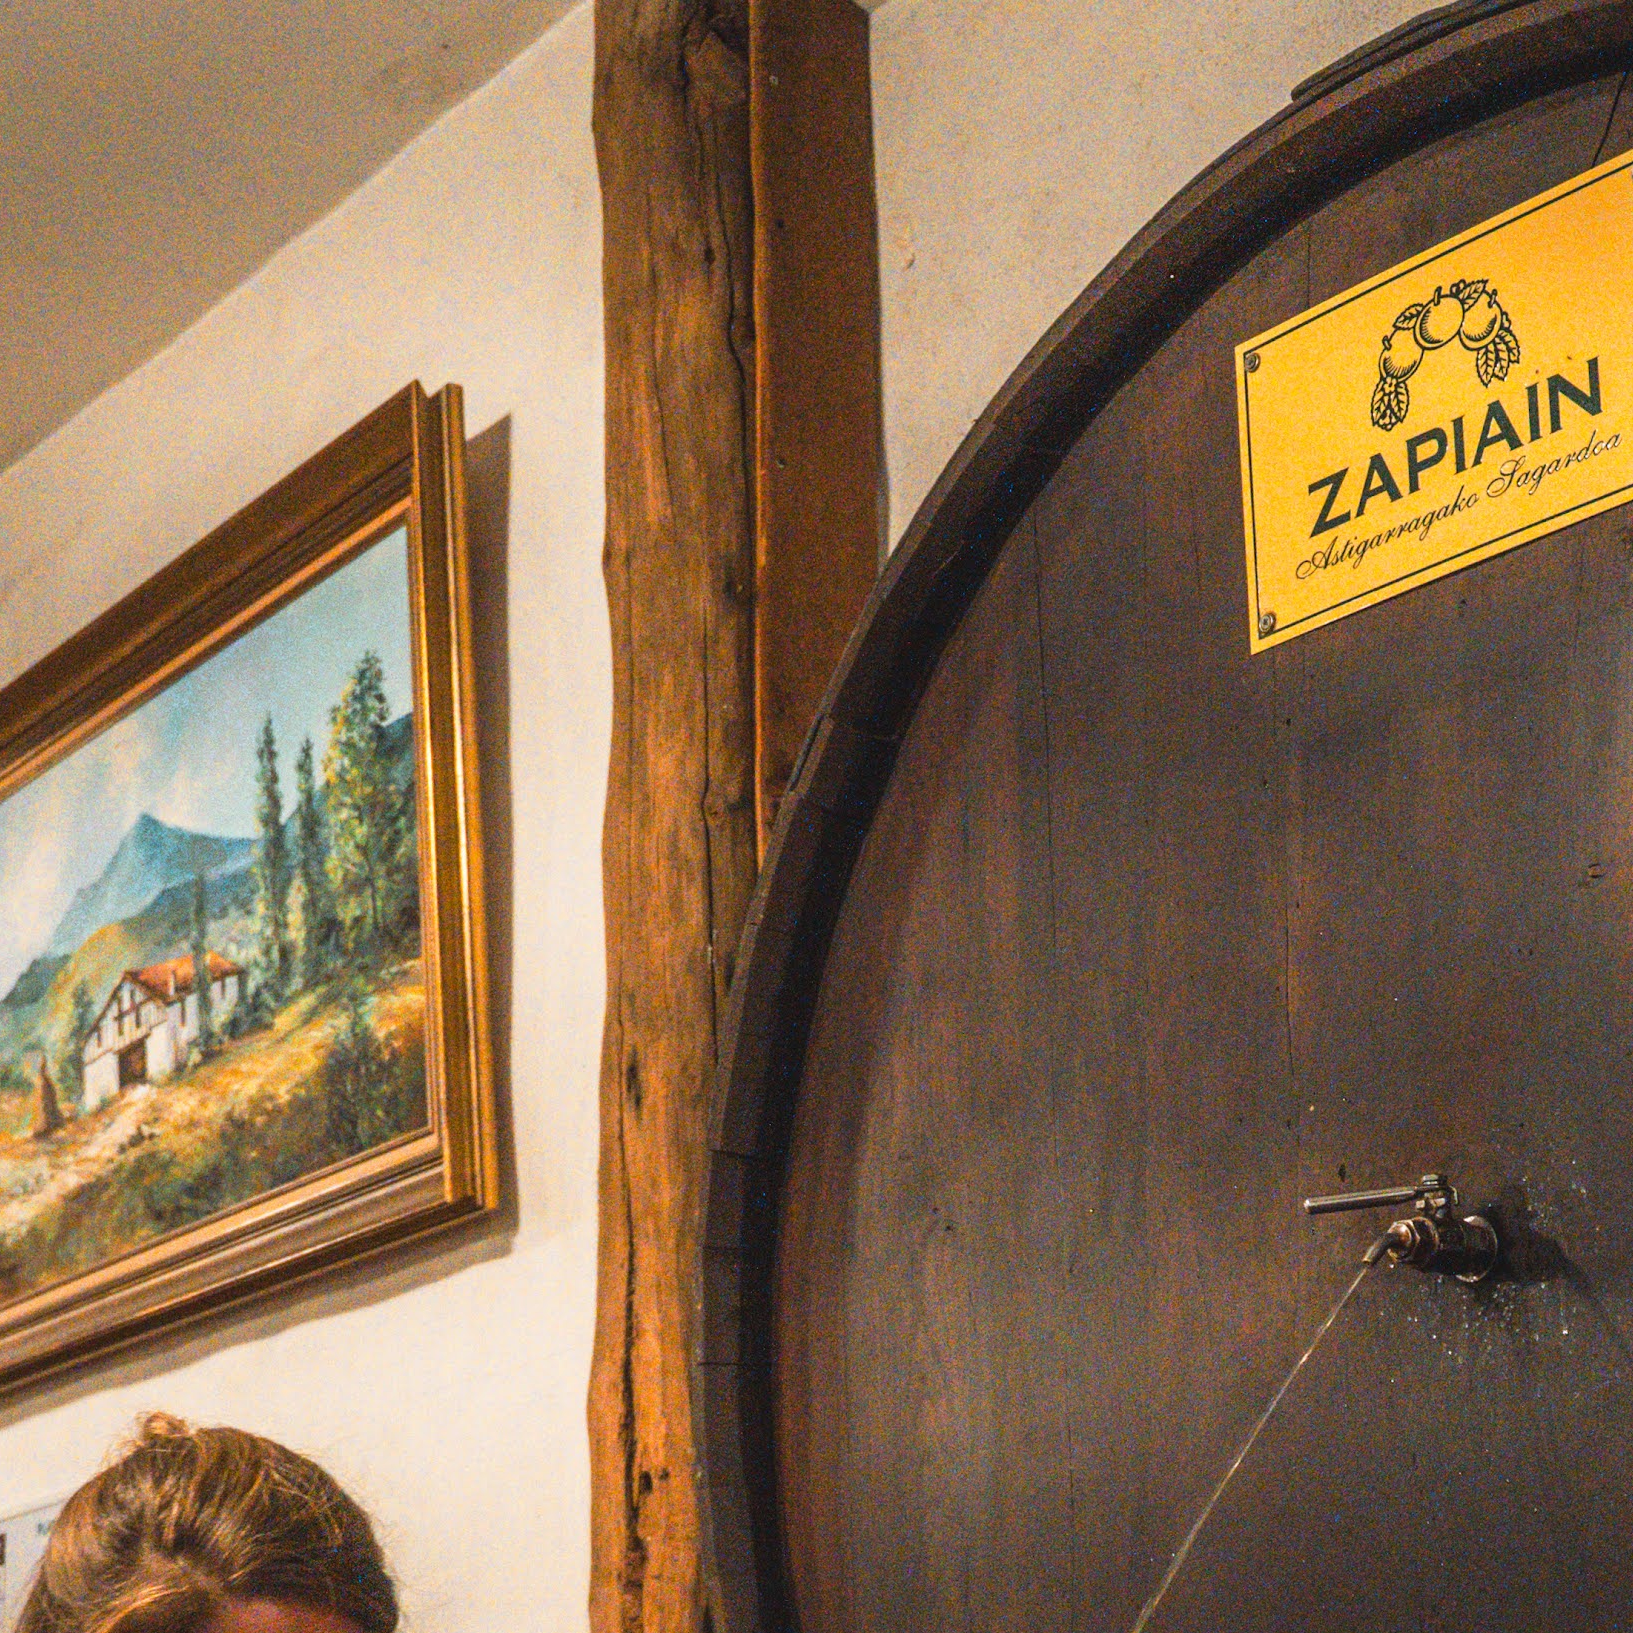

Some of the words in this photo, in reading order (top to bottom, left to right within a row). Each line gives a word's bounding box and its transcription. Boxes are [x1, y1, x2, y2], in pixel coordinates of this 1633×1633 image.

[1295, 484, 1480, 580] Astigarragako
[1486, 429, 1623, 498] Sagardoa
[1308, 356, 1604, 539] ZAPIAIN
